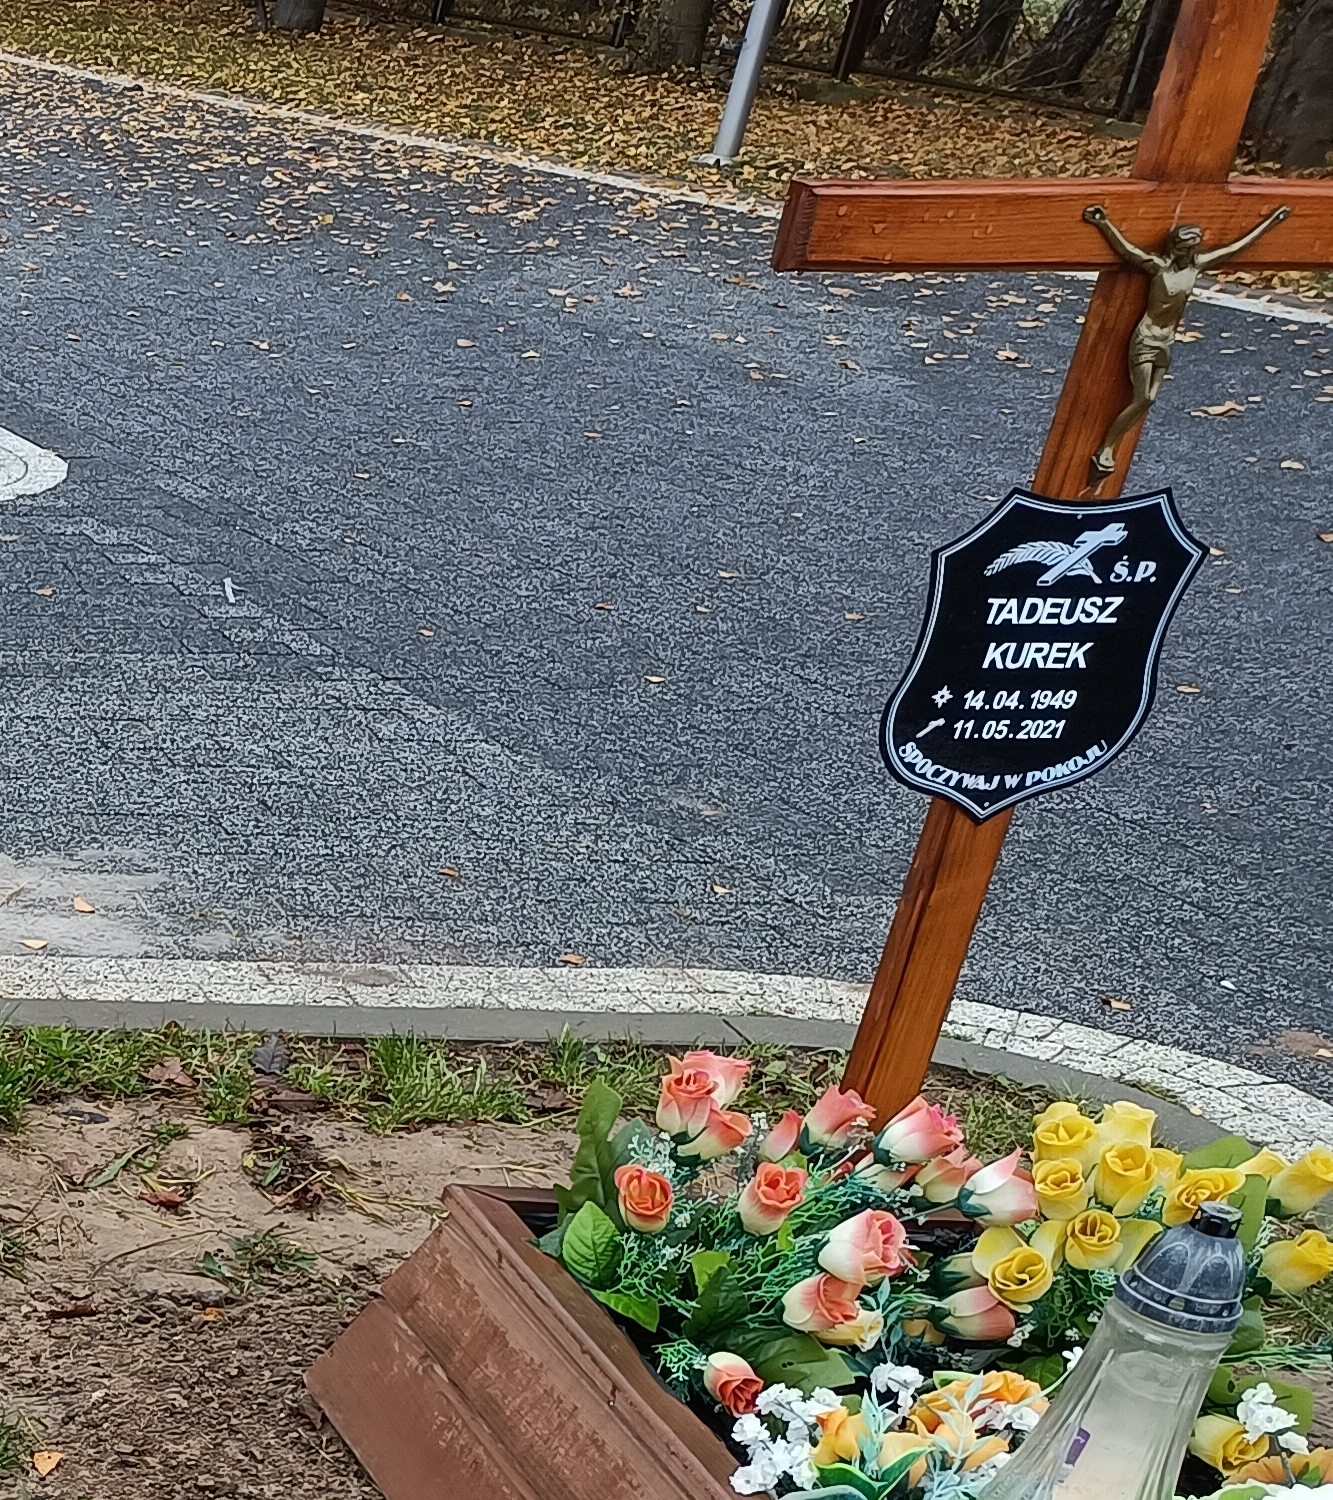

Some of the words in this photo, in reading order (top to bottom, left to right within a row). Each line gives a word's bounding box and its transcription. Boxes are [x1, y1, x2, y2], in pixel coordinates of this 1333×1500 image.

[986, 596, 1125, 624] TADEUSZ
[982, 642, 1094, 669] KUREK
[963, 689, 1077, 710] 14.04.1949
[953, 719, 1066, 739] 11.05.2021
[898, 741, 1000, 790] SPOCZYWAJ
[1003, 772, 1023, 789] W
[1025, 739, 1109, 786] POKOJU
